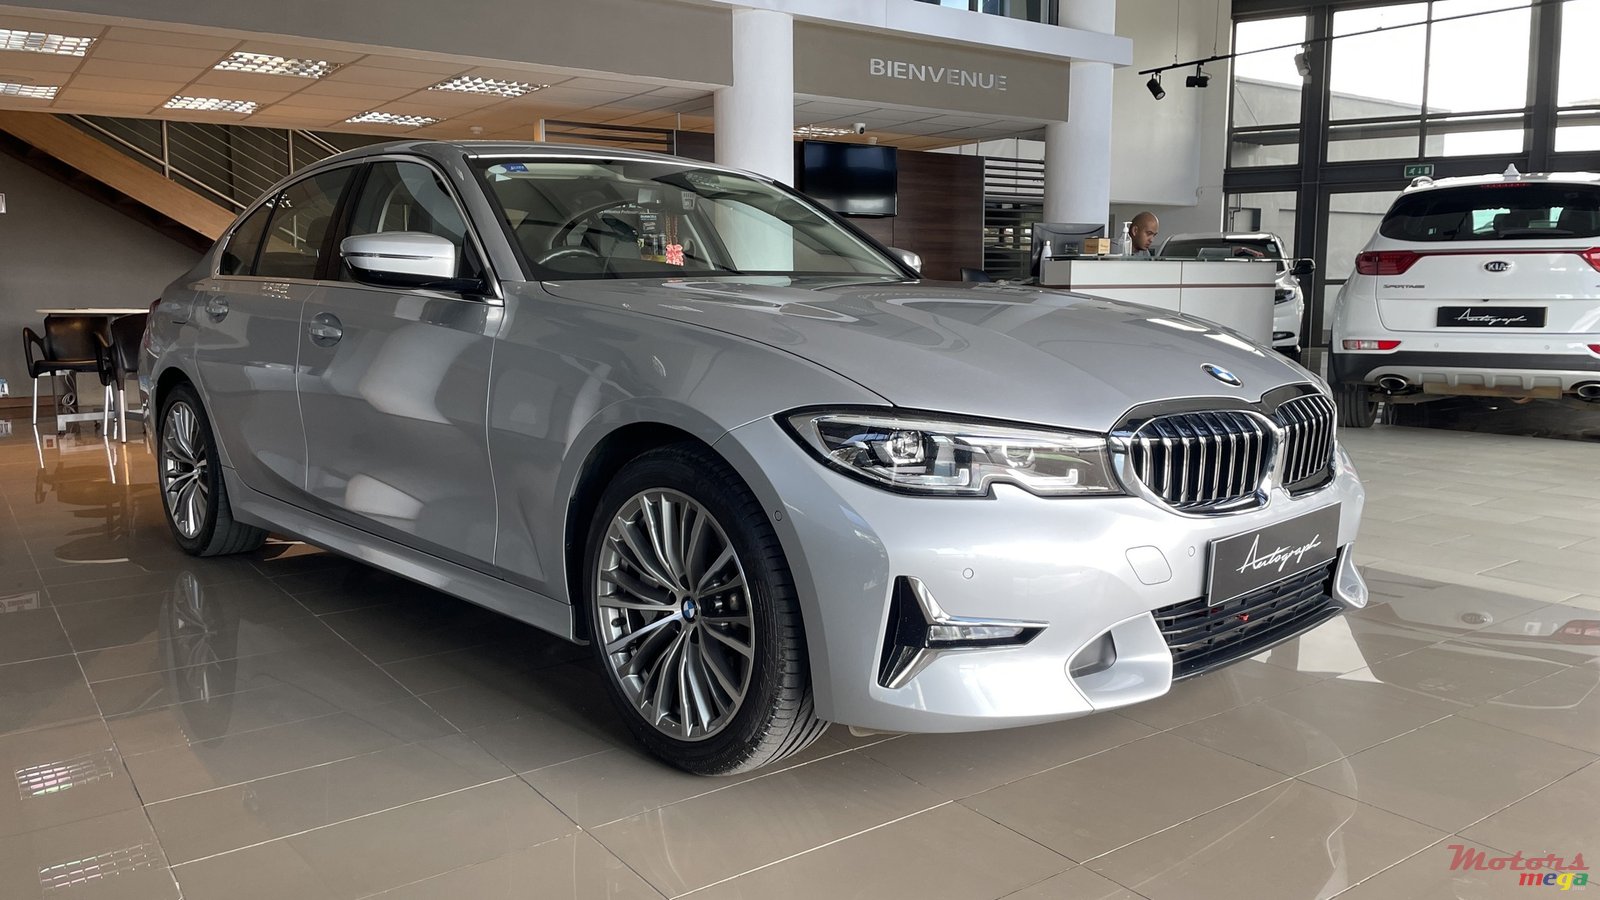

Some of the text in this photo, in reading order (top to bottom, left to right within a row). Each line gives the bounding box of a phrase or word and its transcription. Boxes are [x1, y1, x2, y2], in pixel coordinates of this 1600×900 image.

[870, 58, 1007, 91] BIENVENUE
[1487, 262, 1507, 271] KIA
[1453, 307, 1527, 326] Autograph
[1236, 533, 1322, 574] Autograph
